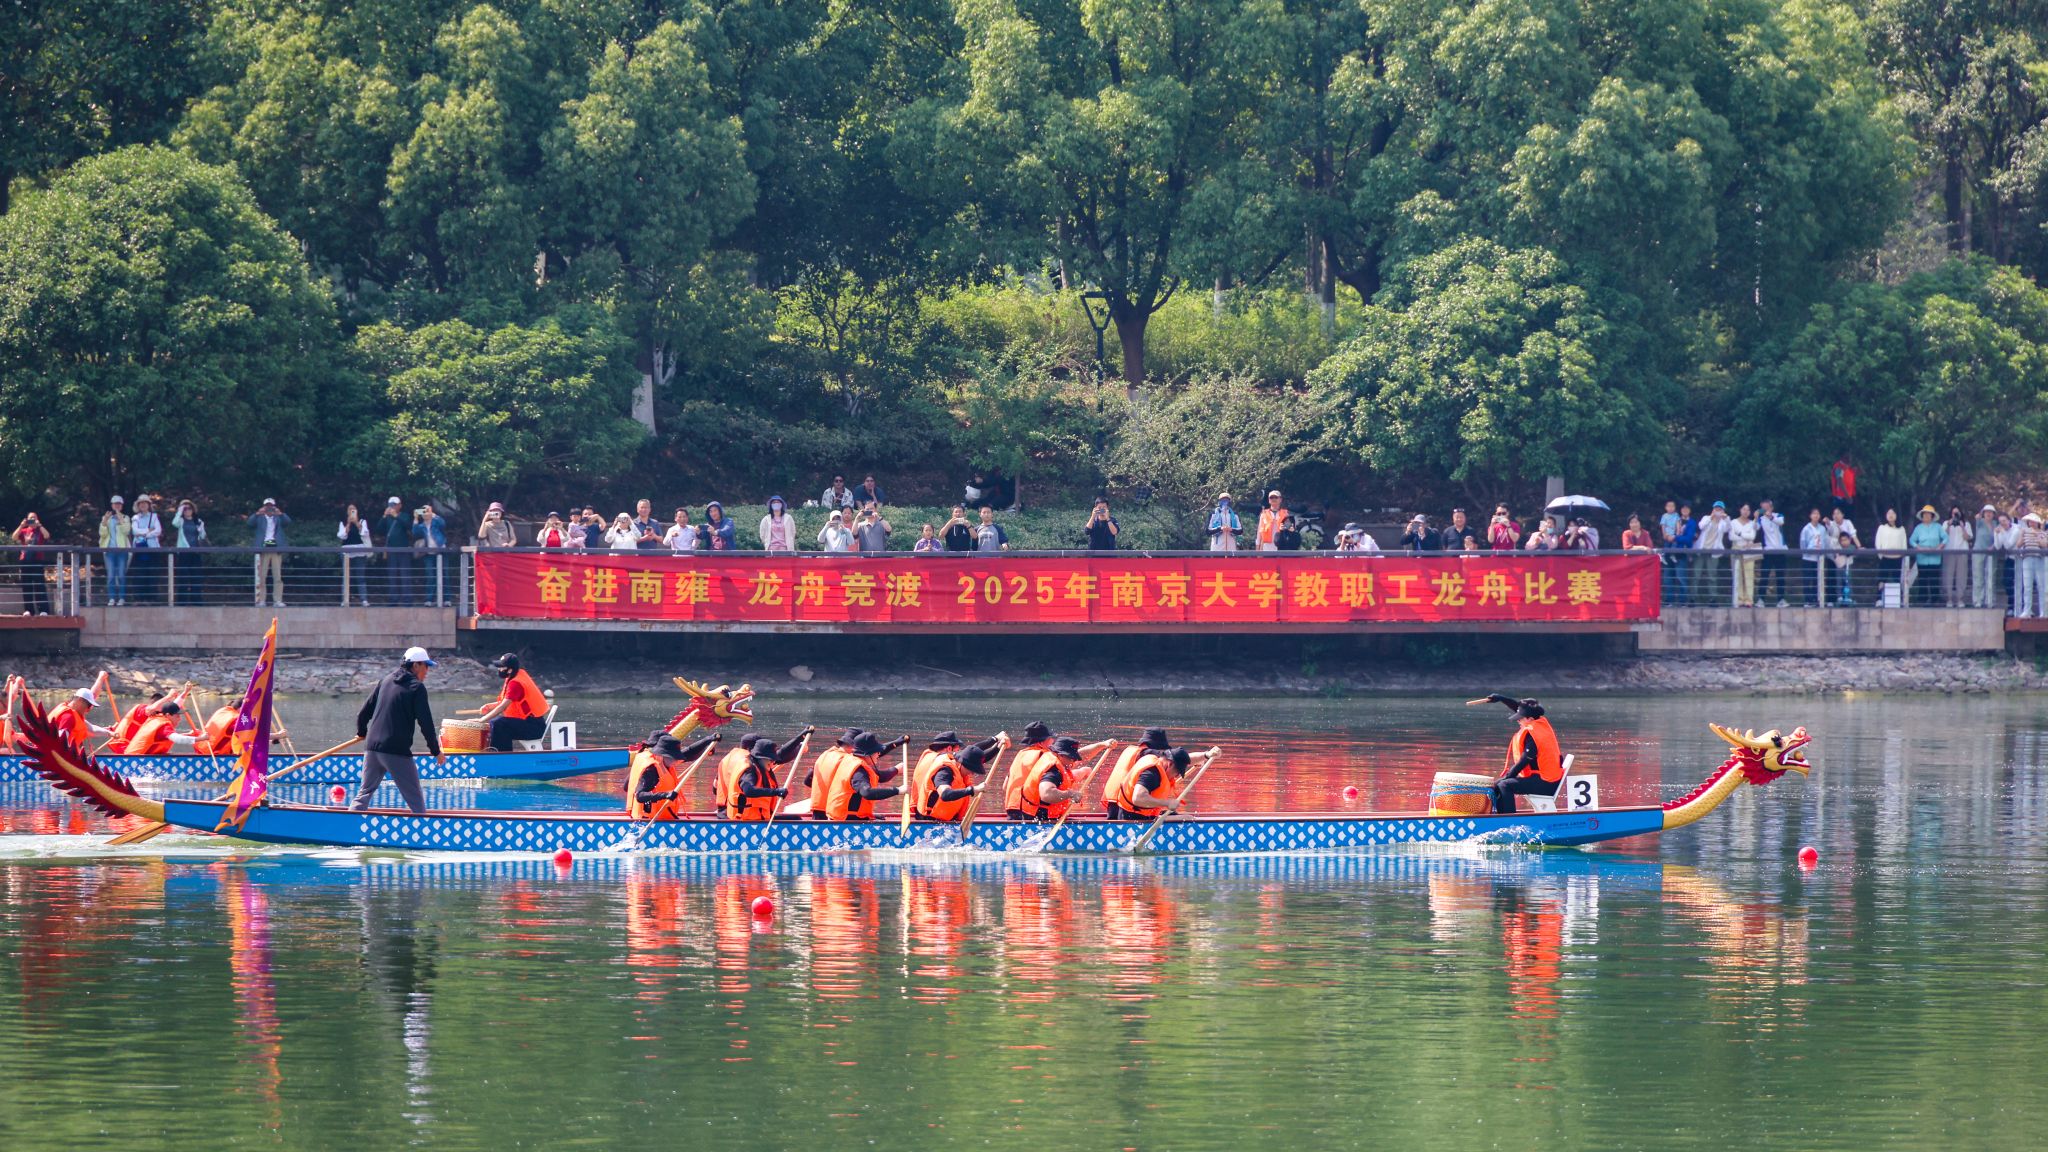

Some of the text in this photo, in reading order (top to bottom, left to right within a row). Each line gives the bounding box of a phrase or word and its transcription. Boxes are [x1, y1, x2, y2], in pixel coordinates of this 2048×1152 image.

[536, 567, 1603, 609] 奋进南雍 龙舟竞渡 2025年南京大学教职工龙舟比赛
[559, 726, 569, 747] 1
[1573, 780, 1592, 807] 3
